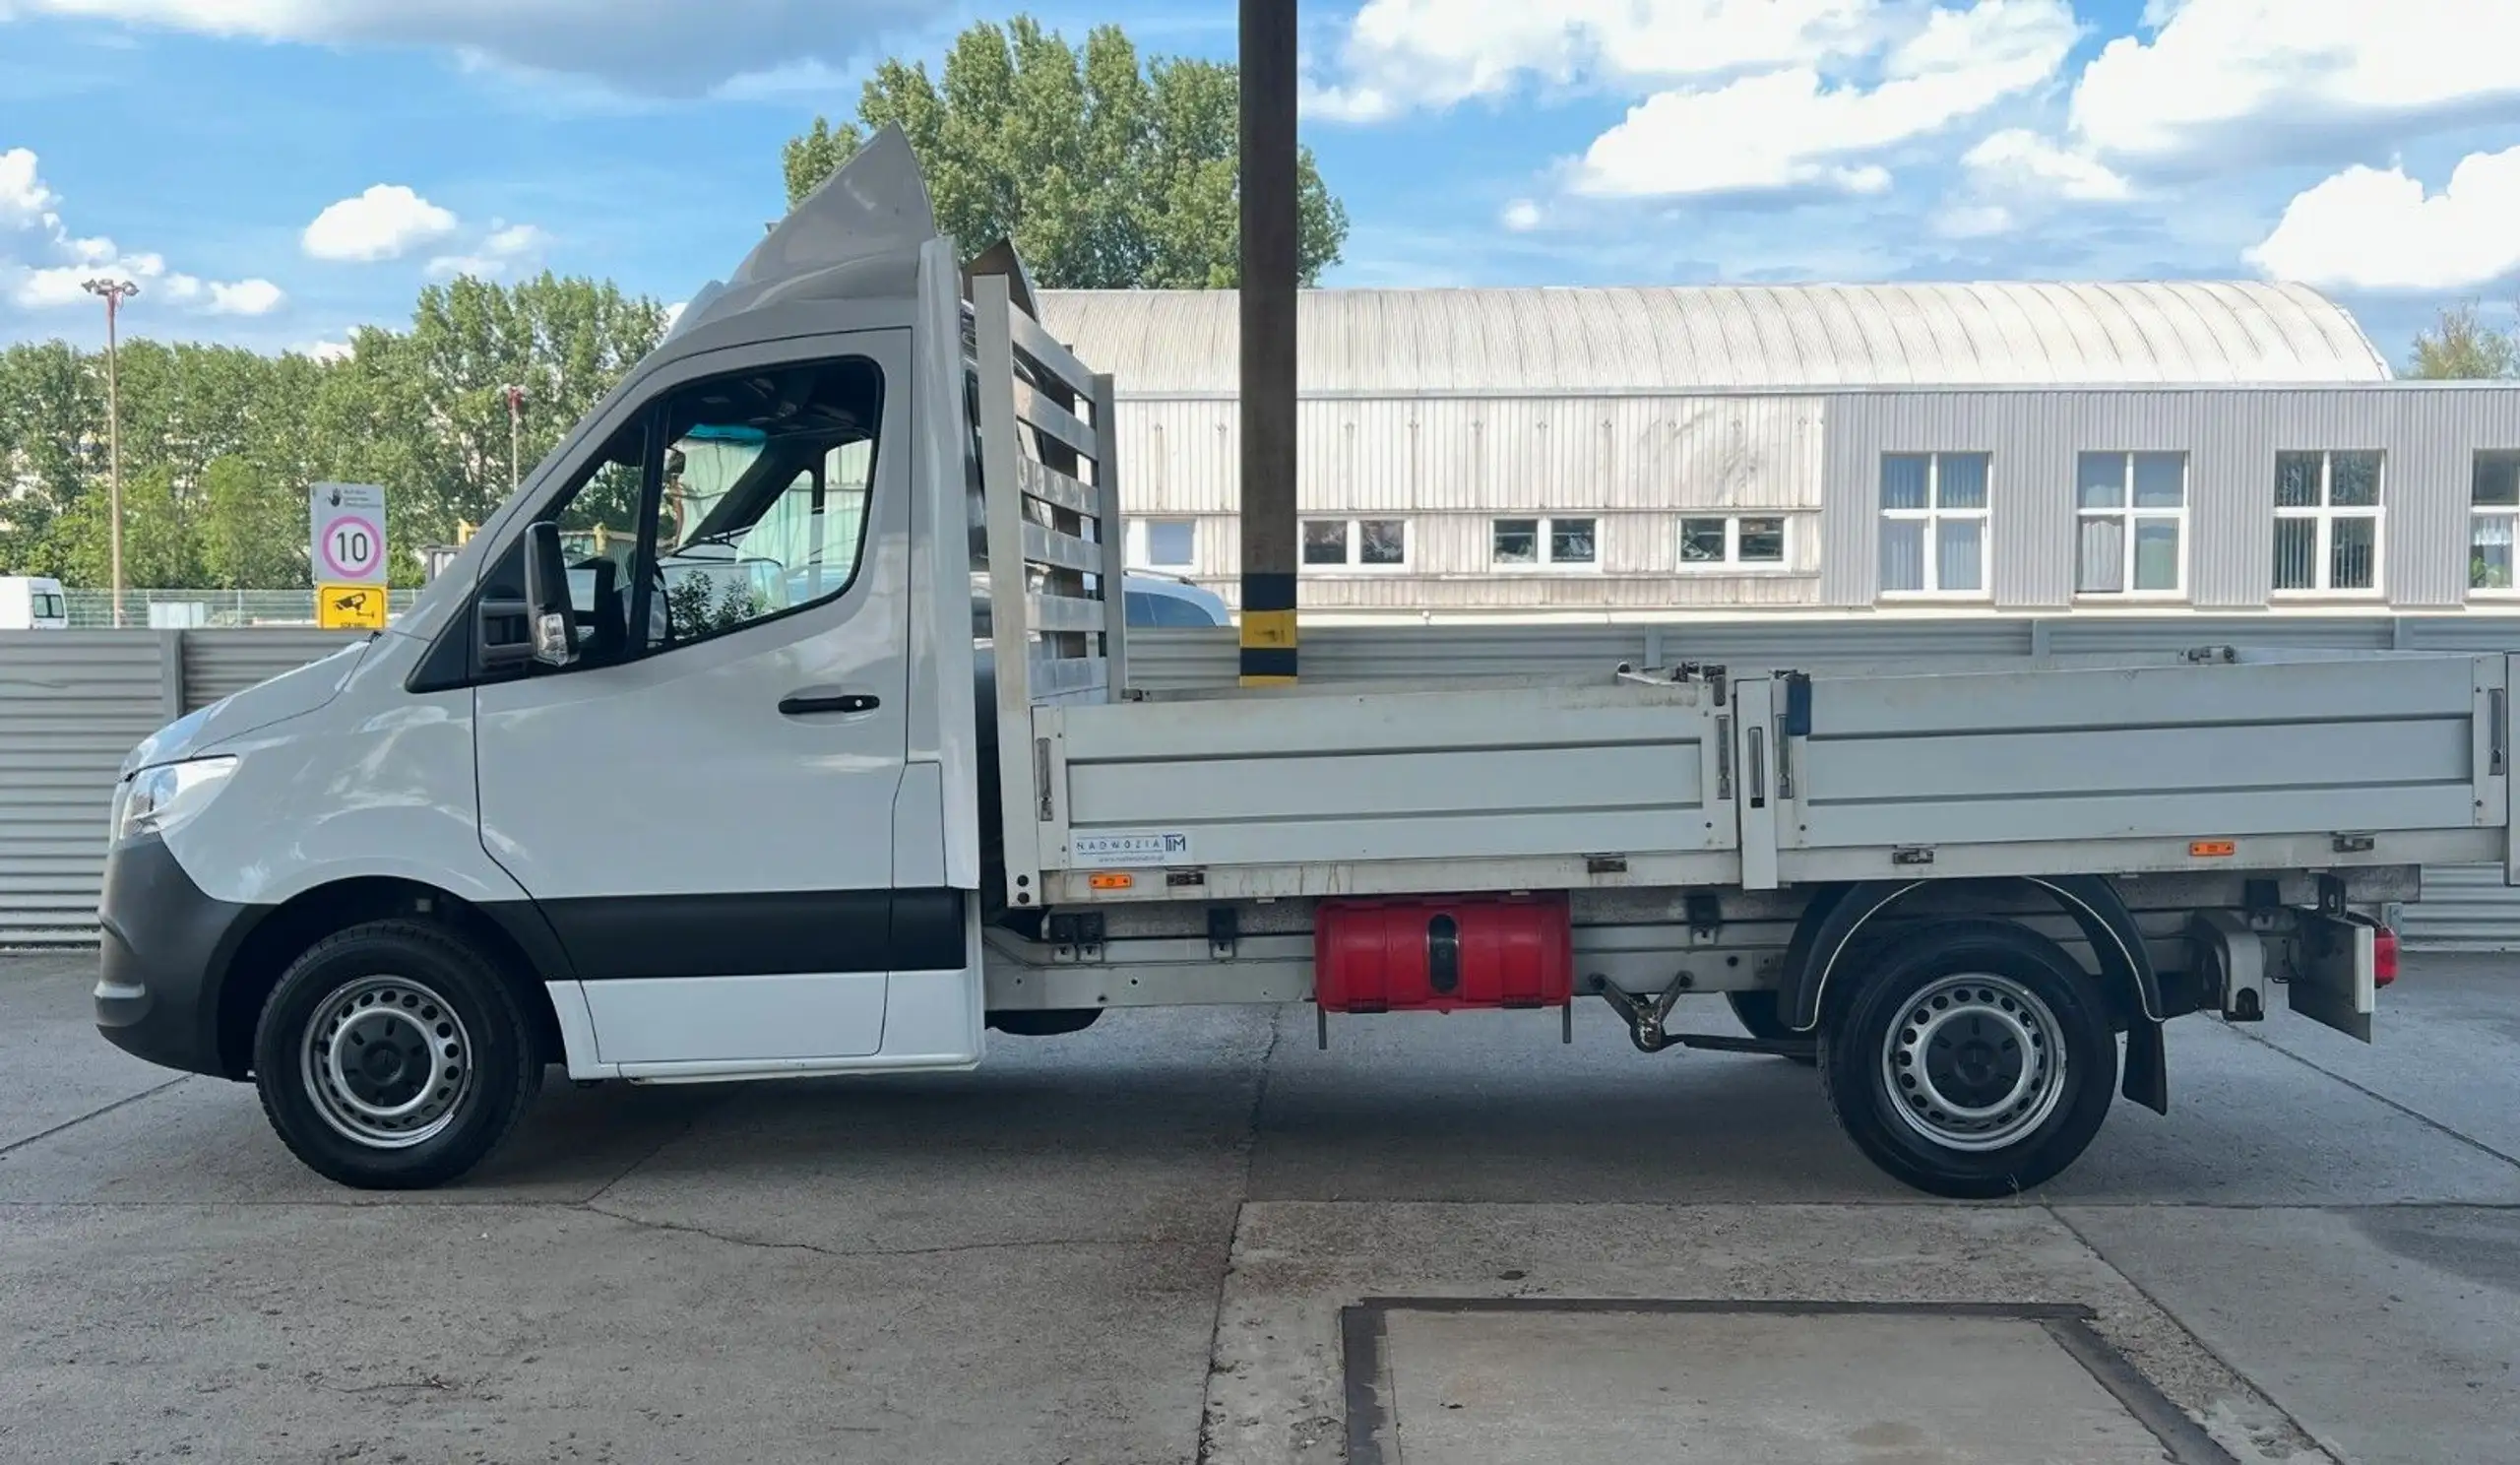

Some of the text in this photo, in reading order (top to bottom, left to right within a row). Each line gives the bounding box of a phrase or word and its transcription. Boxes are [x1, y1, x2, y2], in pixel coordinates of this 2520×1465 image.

[336, 532, 368, 563] 10
[1076, 833, 1186, 853] NADWOZIA TIM
